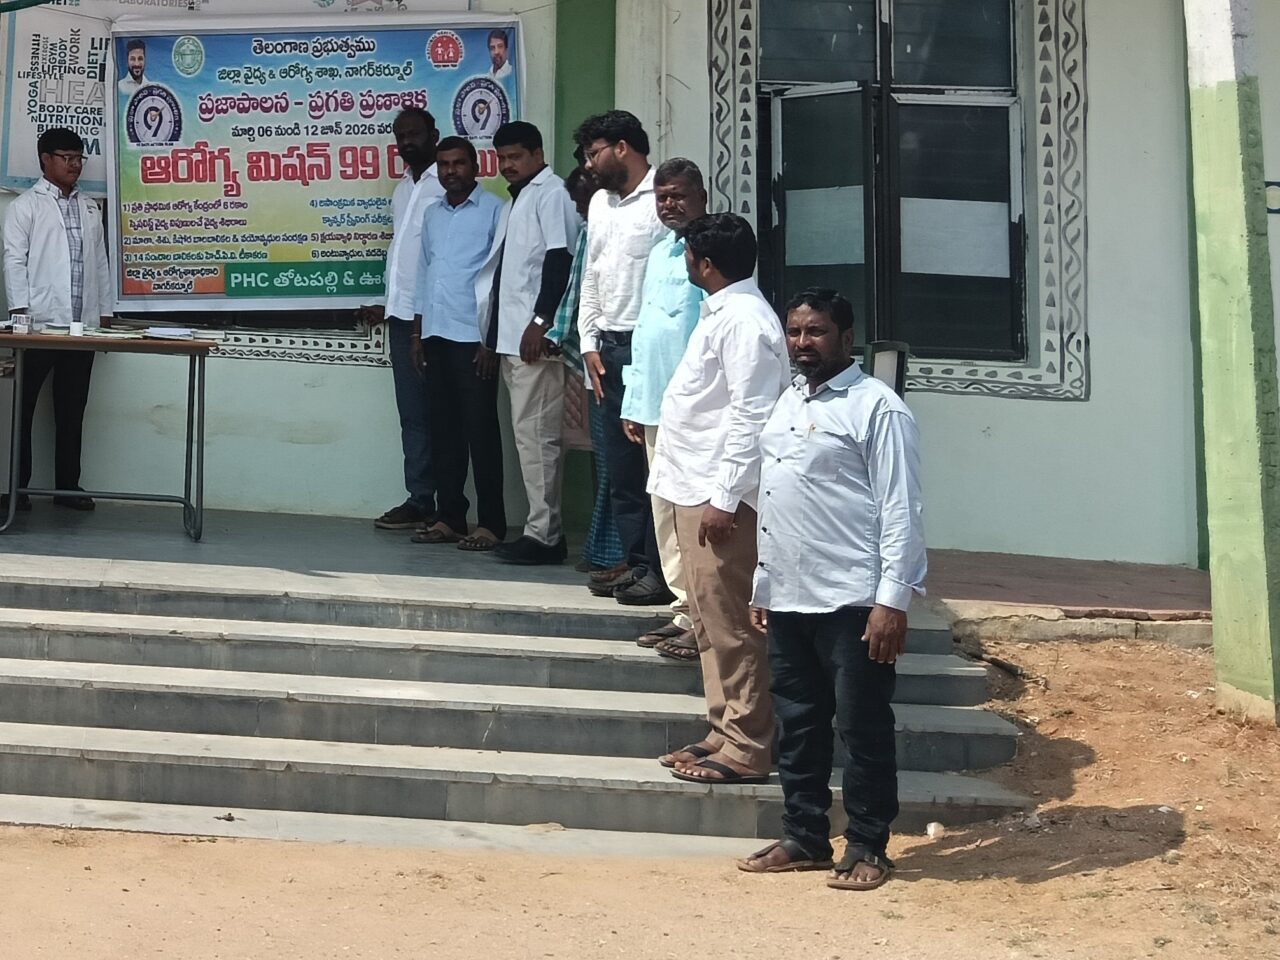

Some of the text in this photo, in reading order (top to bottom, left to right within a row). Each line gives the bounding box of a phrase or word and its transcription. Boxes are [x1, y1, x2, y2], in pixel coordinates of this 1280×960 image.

[31, 33, 40, 71] FITNESS
[49, 42, 58, 65] GYM
[58, 38, 68, 65] BODY
[69, 28, 81, 65] WORK
[252, 37, 376, 60] తెలంగాణ ప్రభుత్వము
[17, 71, 65, 80] LIFESTYLE
[41, 64, 86, 75] LIFTING
[87, 50, 98, 79] DIET
[217, 66, 241, 85] జిల్లా
[242, 67, 267, 85] వైద్య
[268, 71, 276, 80] &
[278, 63, 314, 83] ఆరోగ్య
[314, 65, 342, 80] శాఖ,
[27, 80, 39, 115] YOGA
[198, 93, 289, 122] ప్రజాపాలన
[307, 90, 355, 121] ప్రగతి
[39, 104, 104, 116] BODY CARE
[231, 124, 256, 142] మార్చి
[257, 126, 273, 138] 06
[304, 125, 319, 136] 12
[320, 121, 343, 135] జూన్
[345, 124, 375, 135] 2026
[140, 141, 242, 197] ఆరోగ్య
[246, 142, 333, 187] మిషన్
[339, 145, 380, 180] 99
[133, 253, 144, 261] 14
[230, 268, 355, 293] PHC తోటపల్లి &
